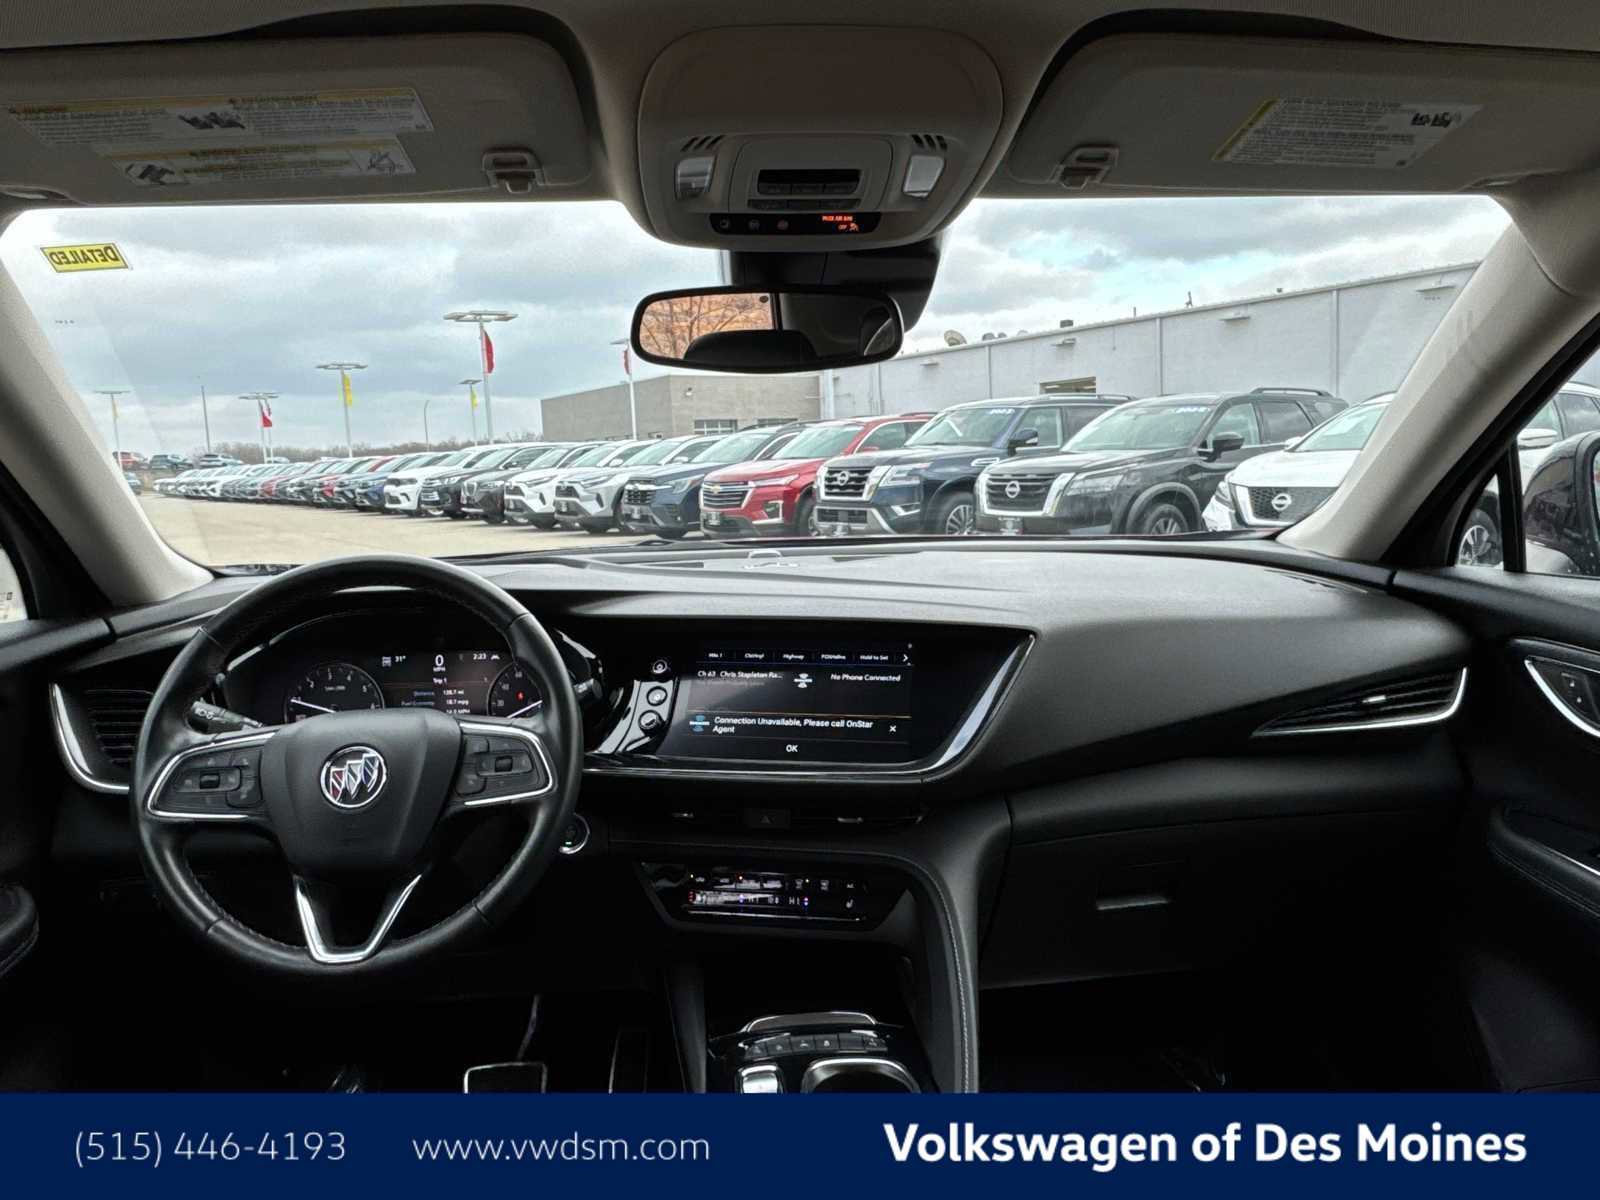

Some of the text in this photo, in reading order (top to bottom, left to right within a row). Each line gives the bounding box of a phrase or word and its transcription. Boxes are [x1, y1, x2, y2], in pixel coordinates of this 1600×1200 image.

[434, 654, 445, 667] 0
[720, 670, 737, 678] Chris
[737, 671, 768, 679] Stapleton
[830, 673, 901, 682] No Phone Connected
[714, 716, 757, 725] Connection
[757, 718, 802, 727] Unavailable,
[803, 718, 830, 727] Please
[830, 720, 845, 728] call
[846, 720, 874, 729] OnStar
[712, 725, 736, 734] Agent
[785, 744, 799, 753] OK
